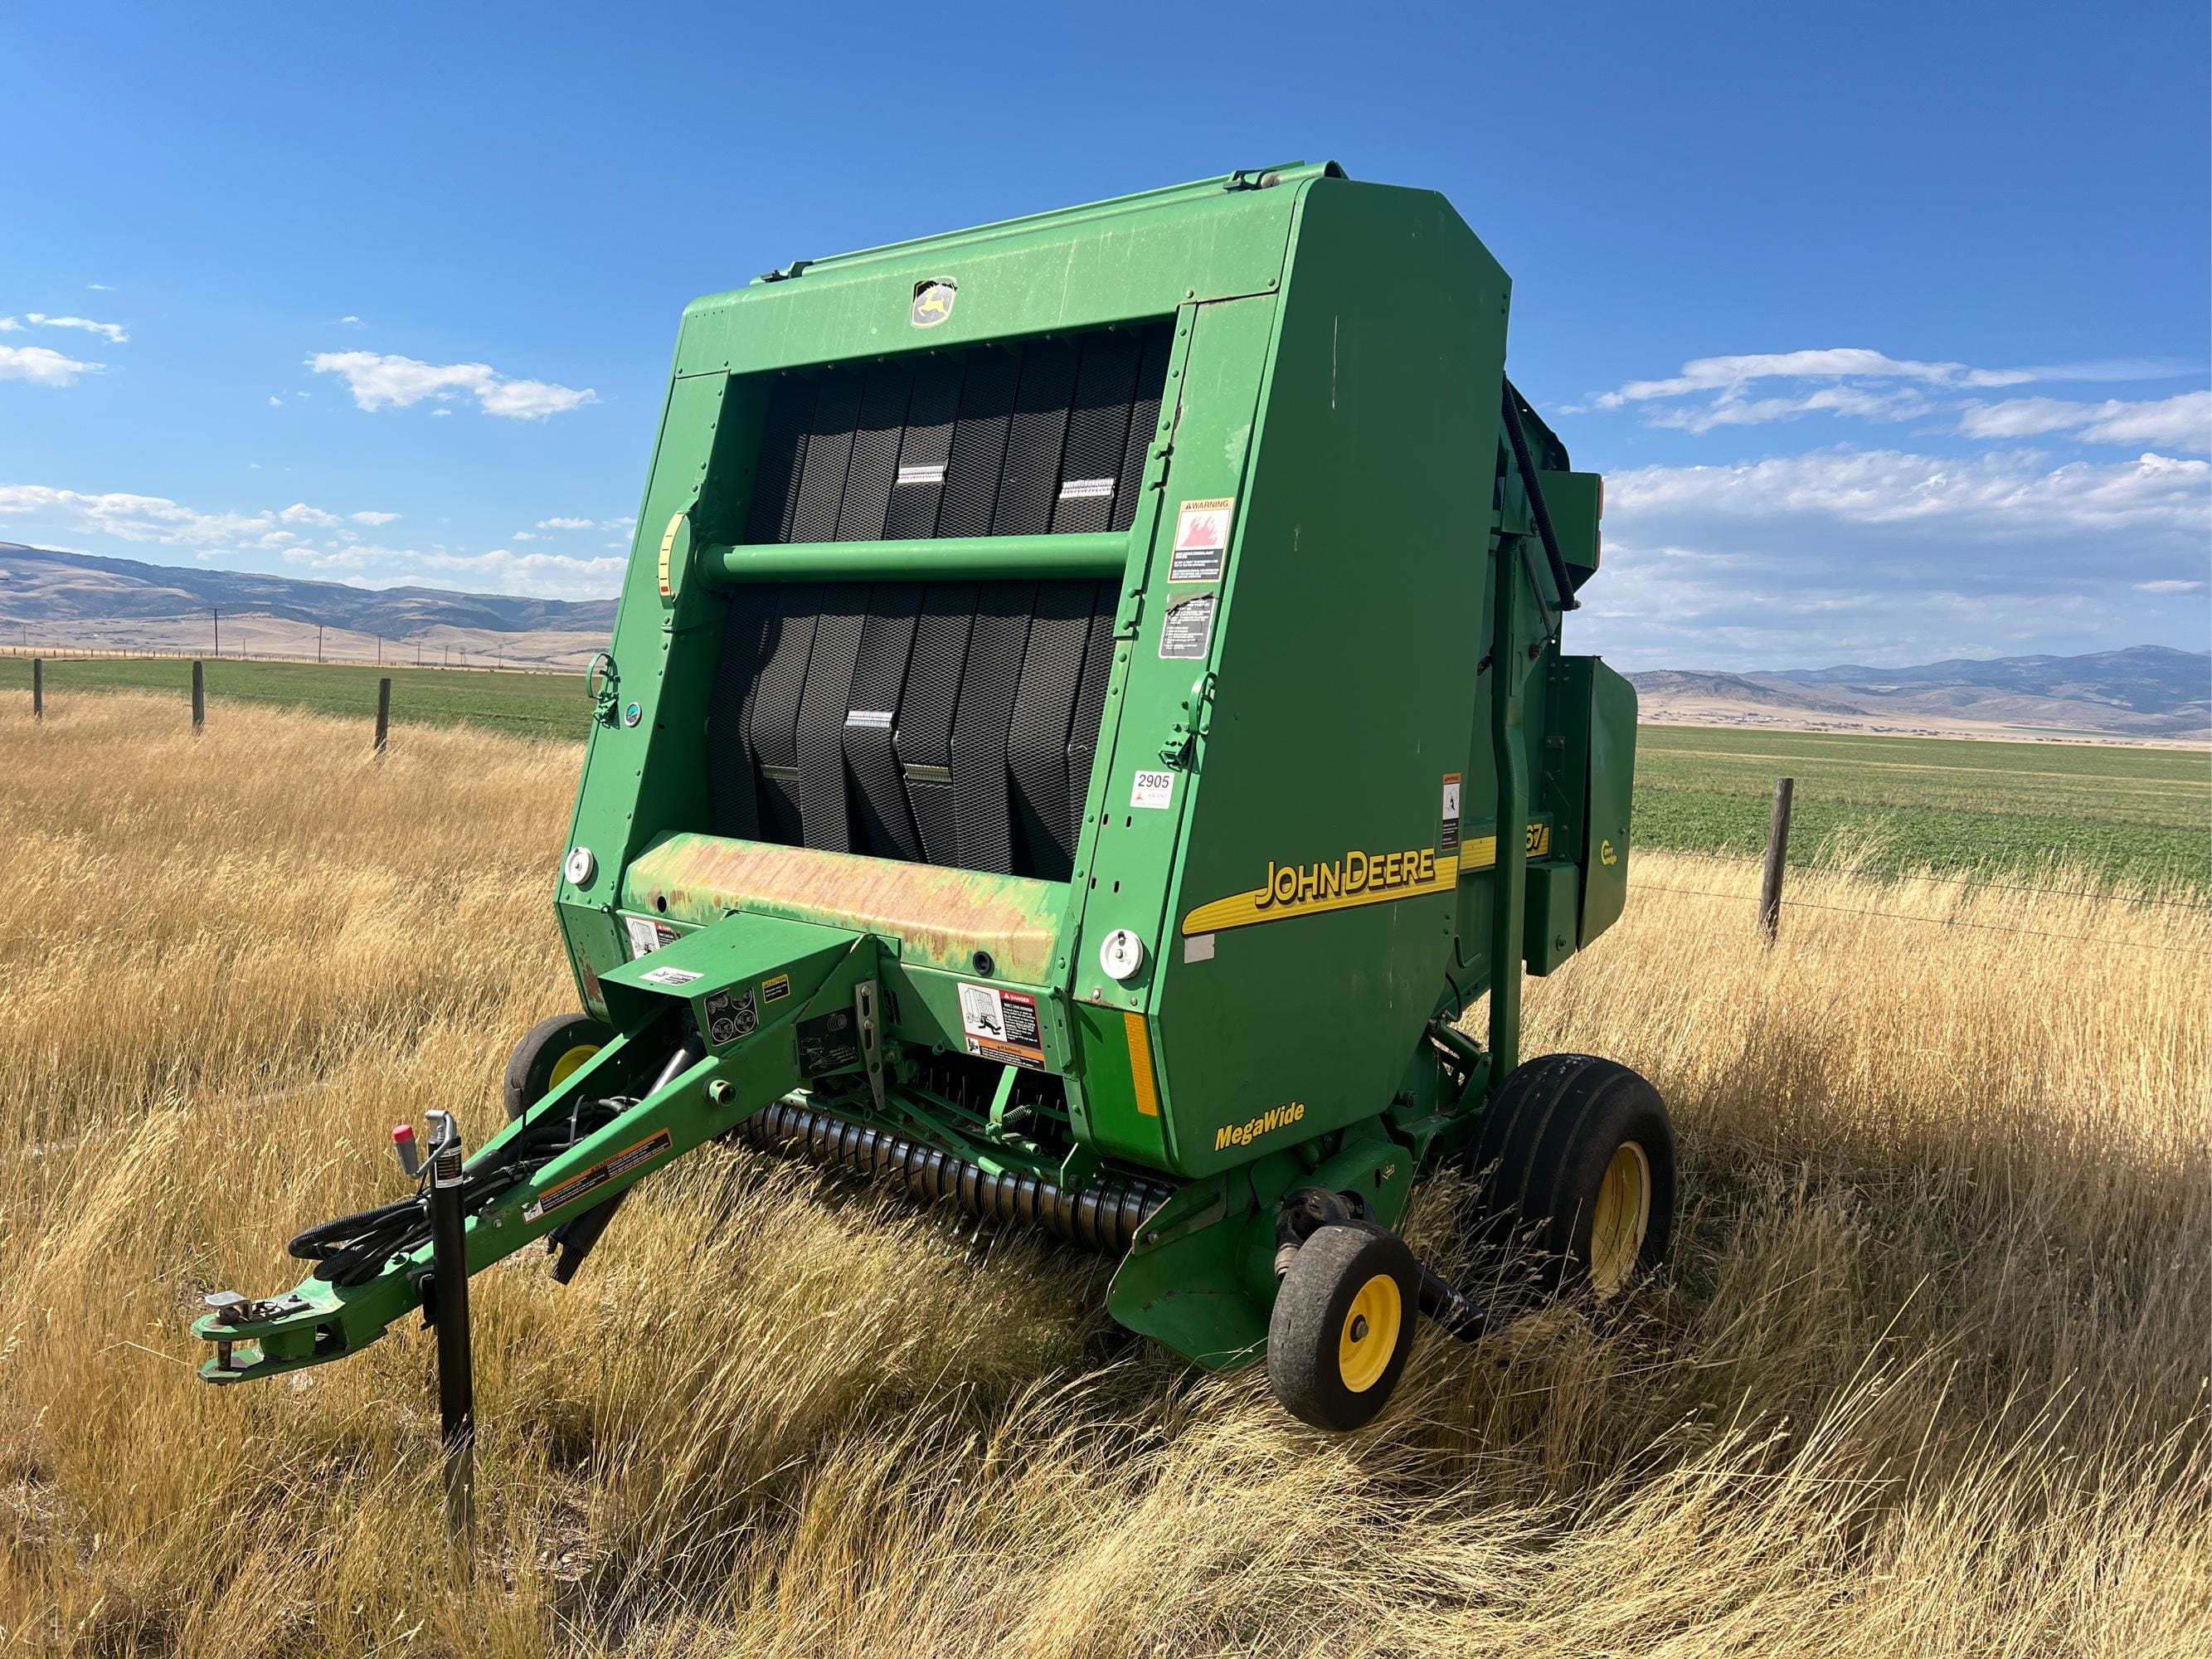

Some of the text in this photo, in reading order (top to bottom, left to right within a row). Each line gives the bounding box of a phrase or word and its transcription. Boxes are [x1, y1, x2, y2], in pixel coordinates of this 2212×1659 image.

[1192, 499, 1228, 509] WARNING
[1138, 774, 1170, 788] 2905
[1255, 848, 1436, 907] JOHN DEERE
[1214, 1101, 1305, 1151] MegaWide
